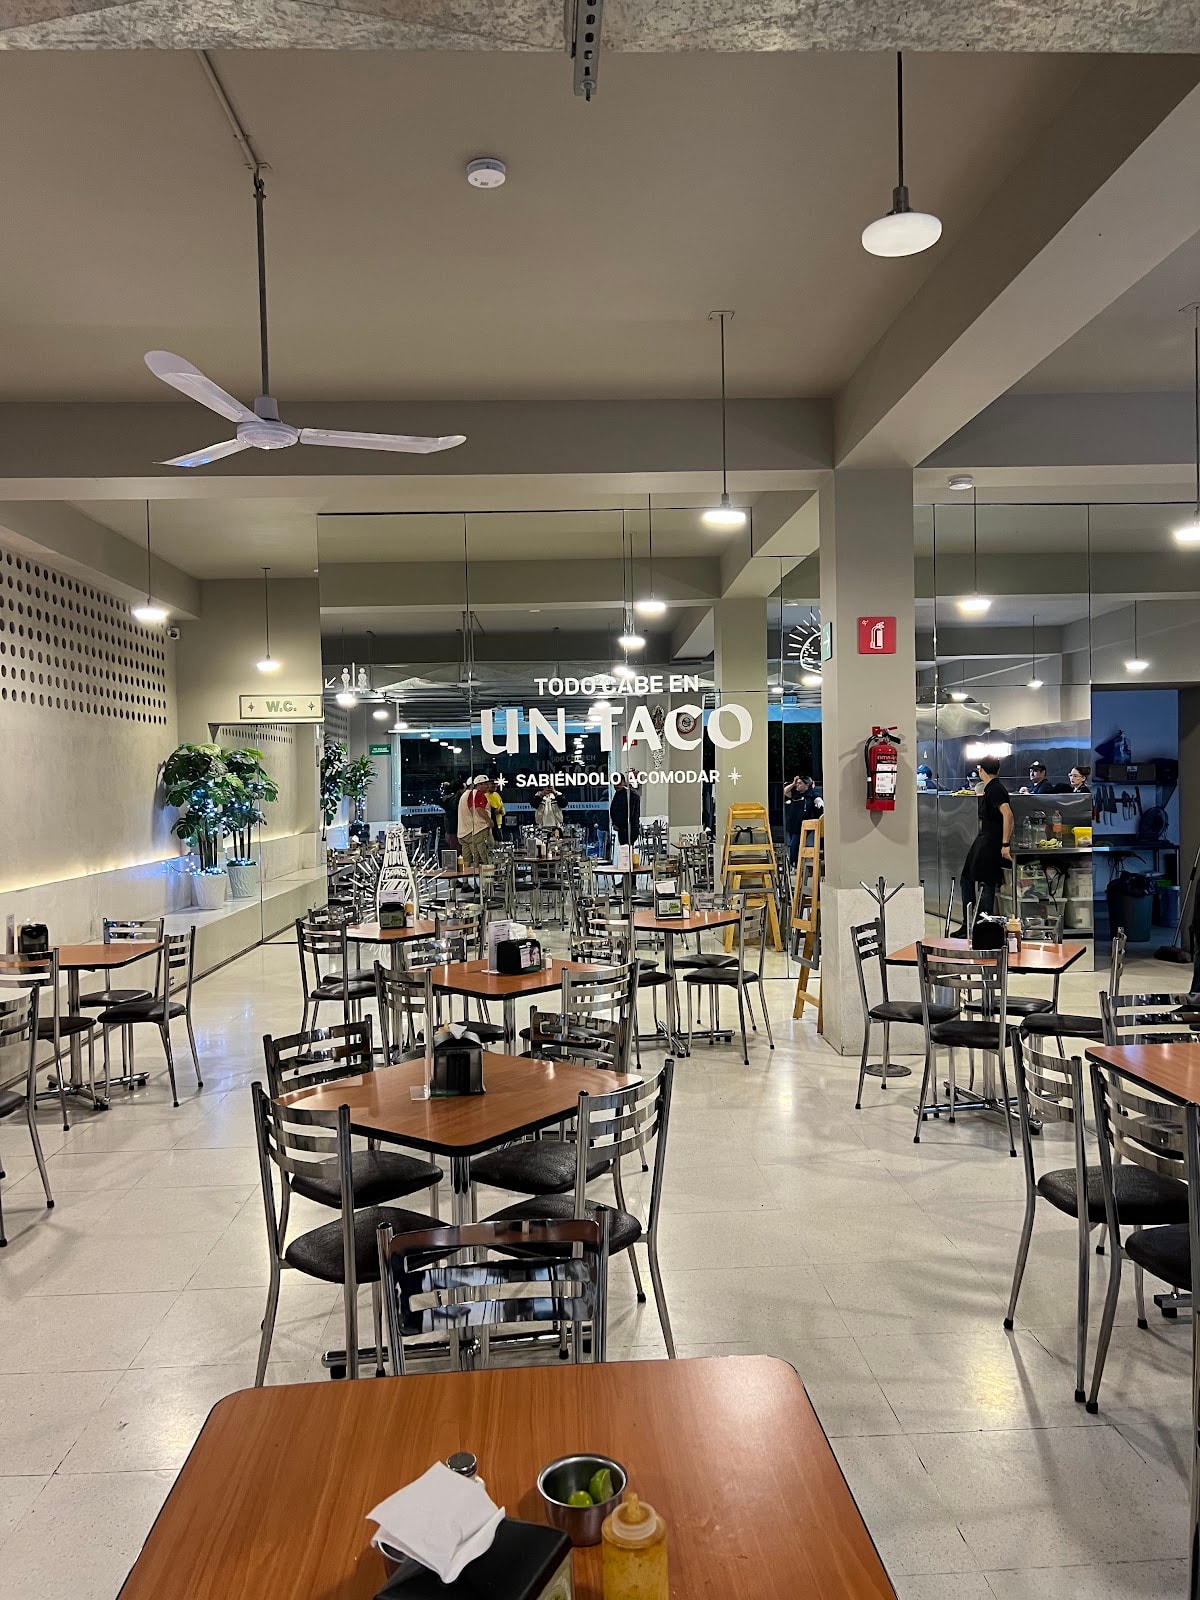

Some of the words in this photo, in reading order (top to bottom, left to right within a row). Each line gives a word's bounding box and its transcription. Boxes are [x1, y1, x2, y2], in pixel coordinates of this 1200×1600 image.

[534, 677, 596, 696] TODO
[601, 675, 664, 695] CABE
[669, 674, 700, 694] EN
[265, 700, 297, 713] W.C.
[480, 707, 566, 755] UN
[588, 703, 753, 752] TACO
[515, 770, 622, 788] SABIÉNDOLO
[628, 769, 720, 785] ACOMODAR
